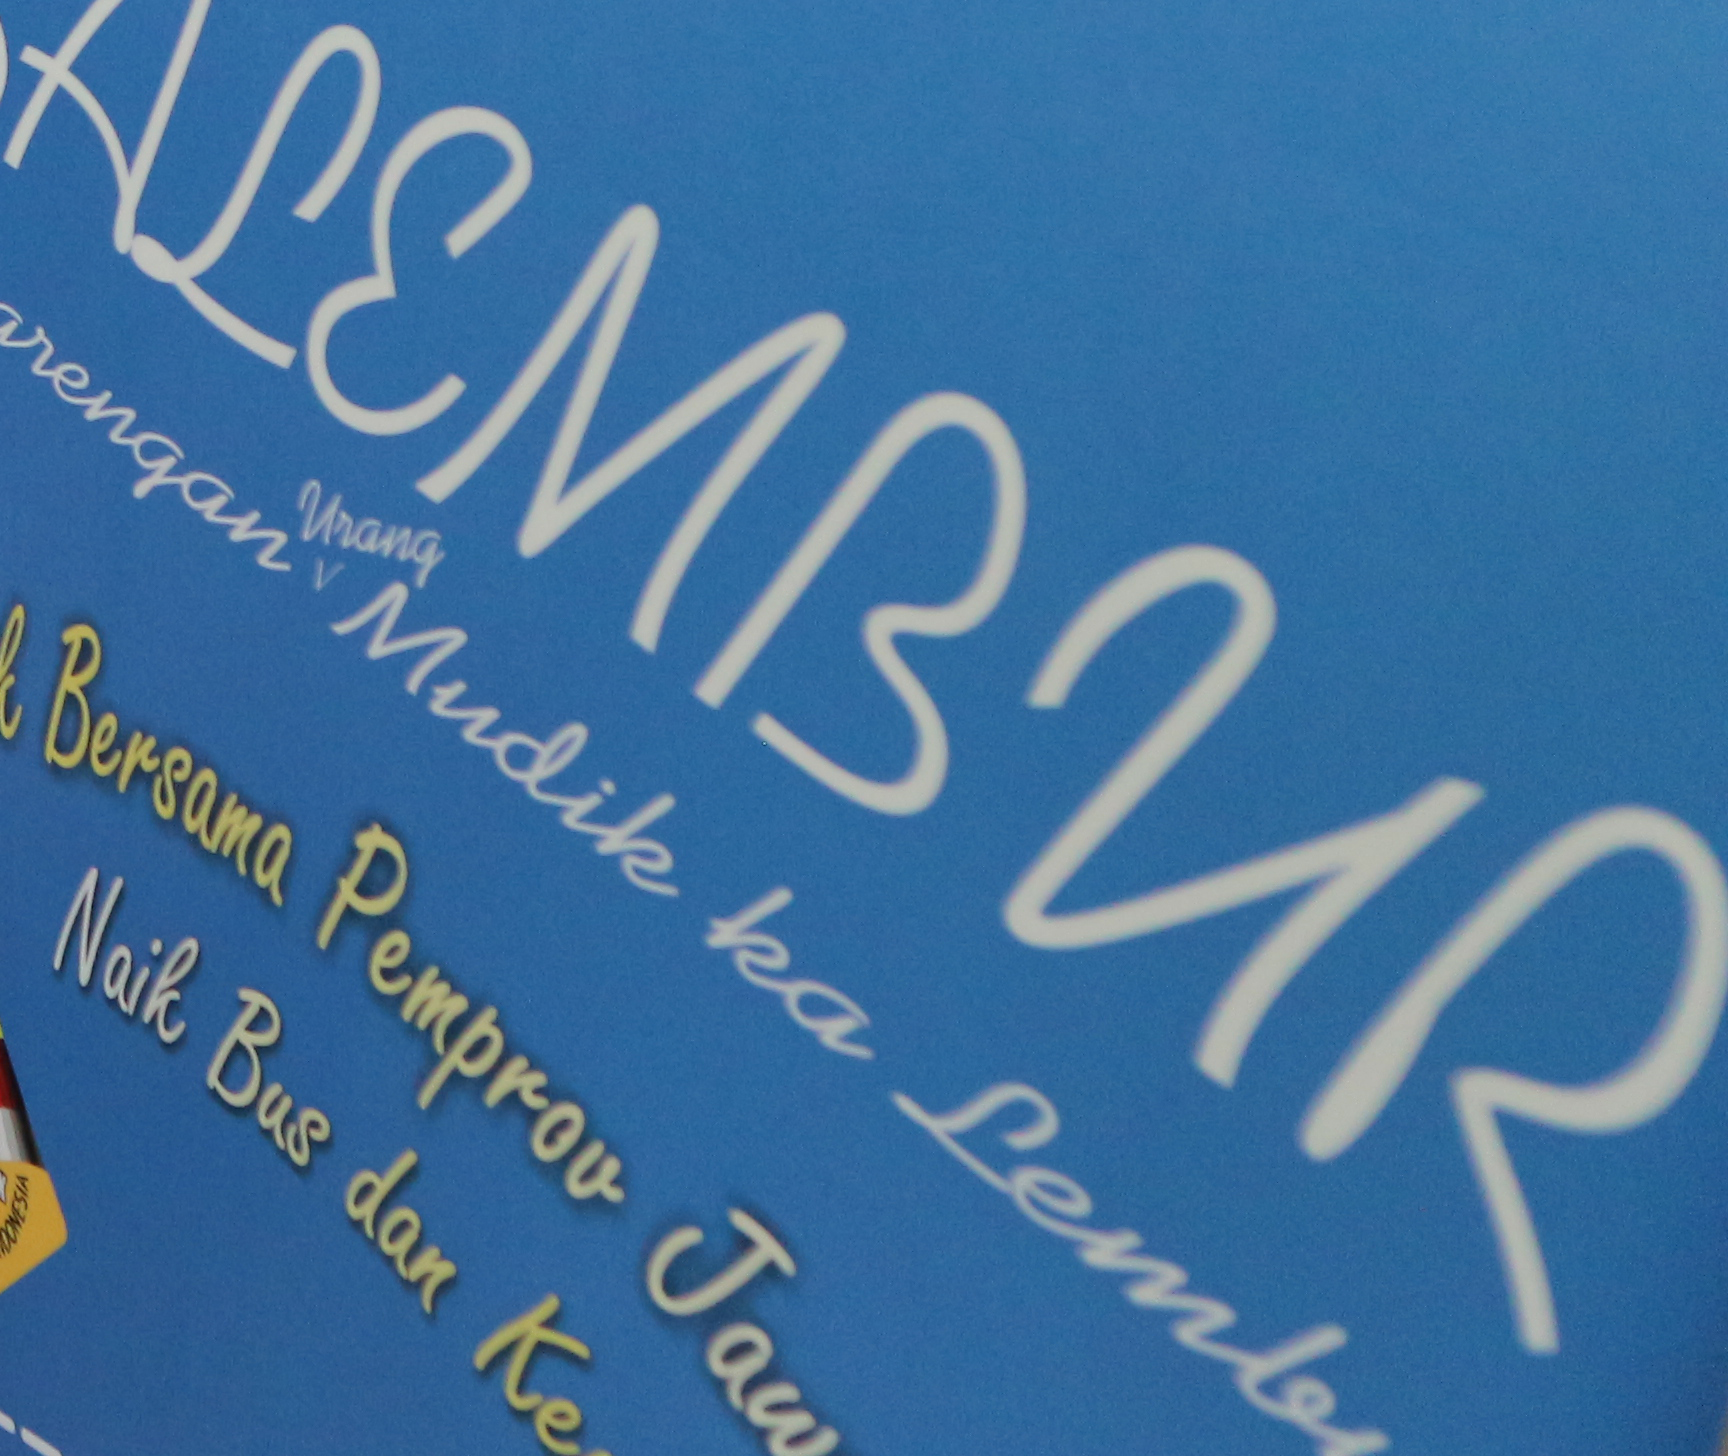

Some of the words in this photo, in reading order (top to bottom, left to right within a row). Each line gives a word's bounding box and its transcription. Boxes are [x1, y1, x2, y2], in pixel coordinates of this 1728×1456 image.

[298, 479, 444, 589] Urang
[45, 624, 294, 907] Bersama
[316, 821, 625, 1205] Pemprov
[330, 581, 680, 897] Mudik
[704, 886, 875, 1060] ka
[53, 867, 200, 1043] Naik
[206, 988, 331, 1166] Bus
[344, 1148, 457, 1314] dan
[473, 1293, 612, 1456] Ke
